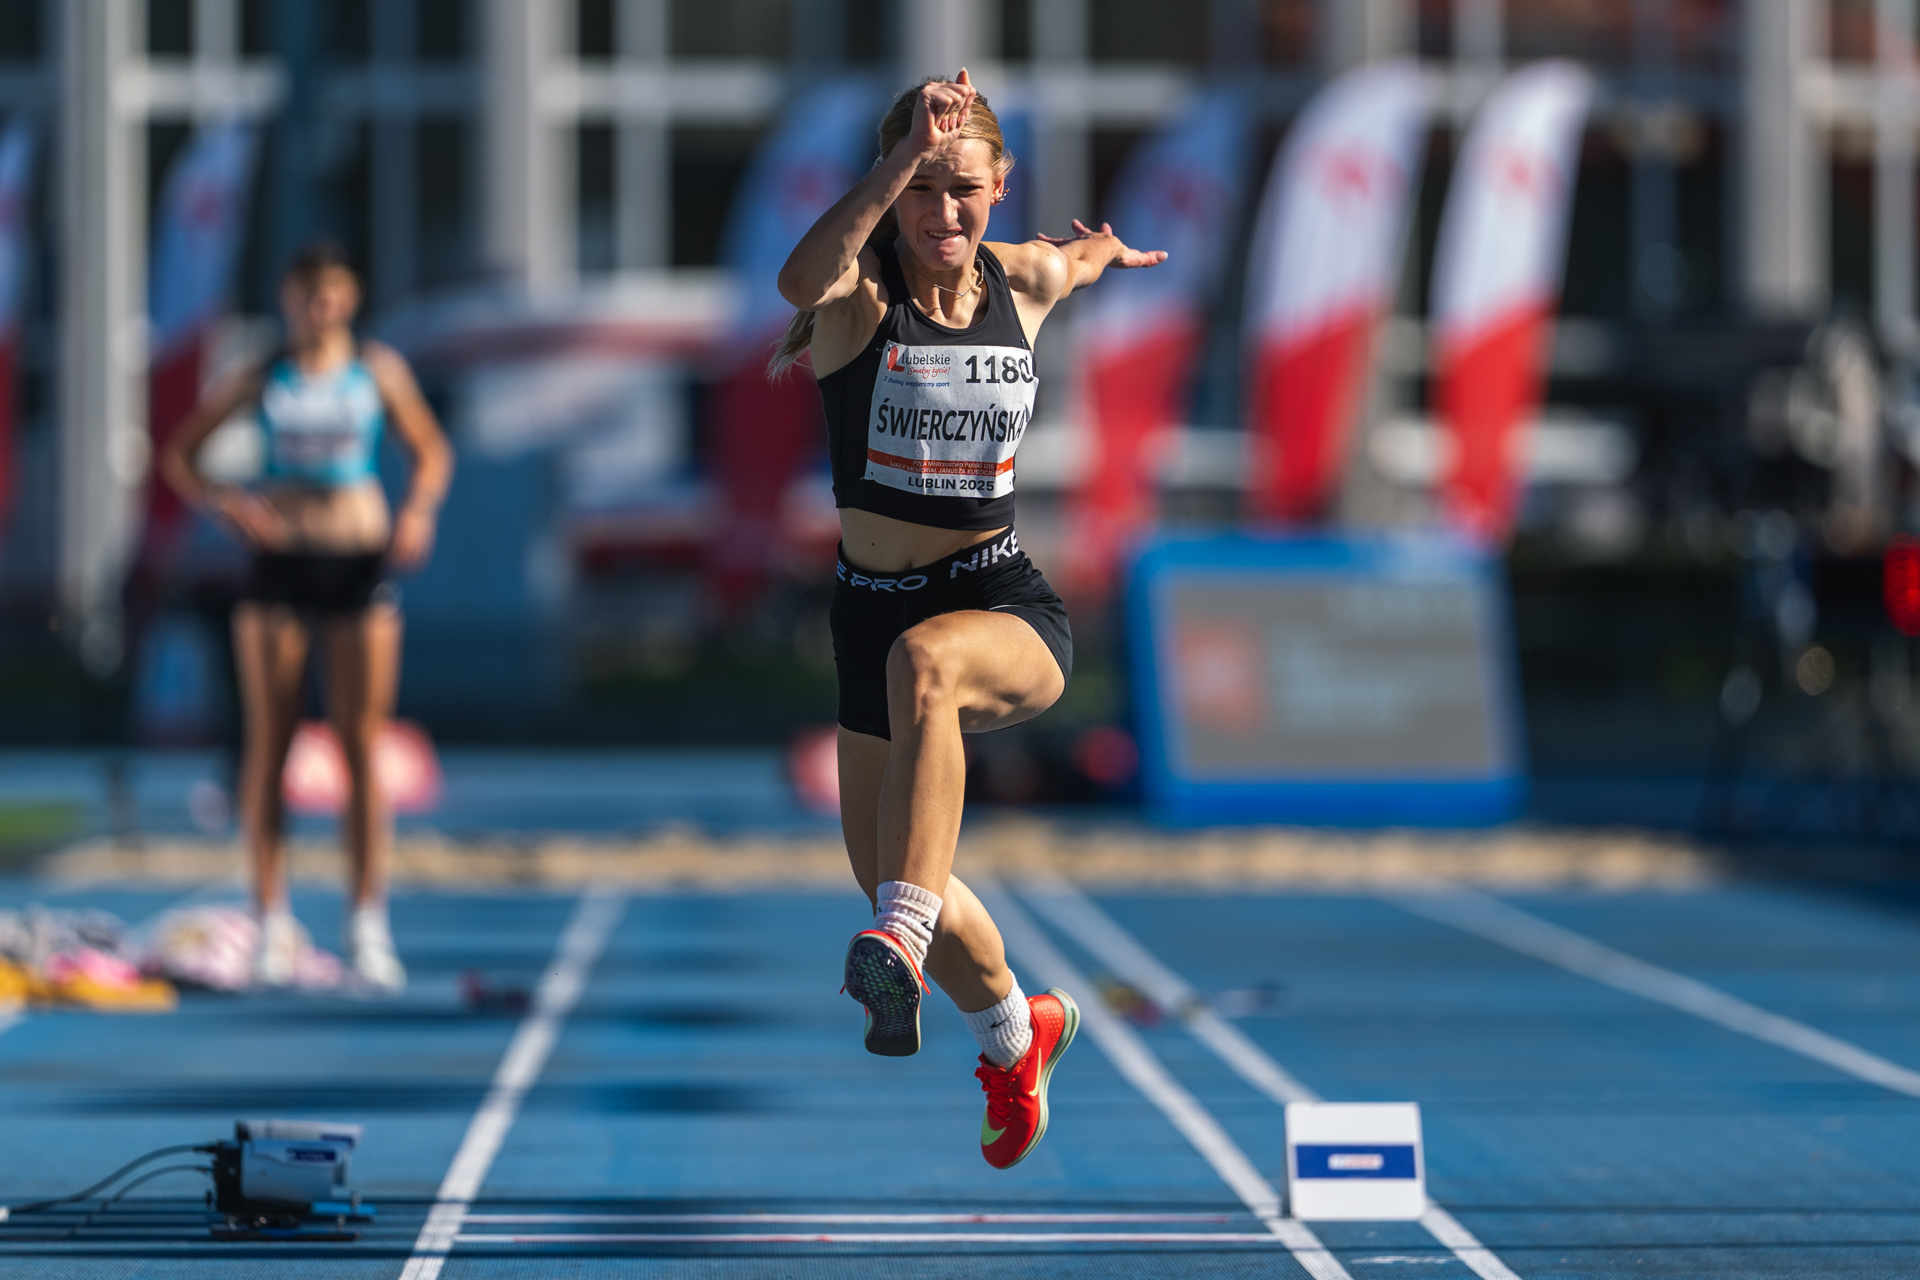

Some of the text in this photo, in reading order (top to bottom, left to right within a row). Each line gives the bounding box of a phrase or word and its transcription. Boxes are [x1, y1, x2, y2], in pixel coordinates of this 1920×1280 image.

[964, 355, 1034, 384] 1180
[876, 398, 1026, 442] ŚWIERCZYŃSKA
[928, 461, 964, 469] Mistrzostwa
[908, 476, 995, 492] LUBLIN 2025
[850, 572, 928, 592] PRO
[950, 530, 1019, 579] NIKE
